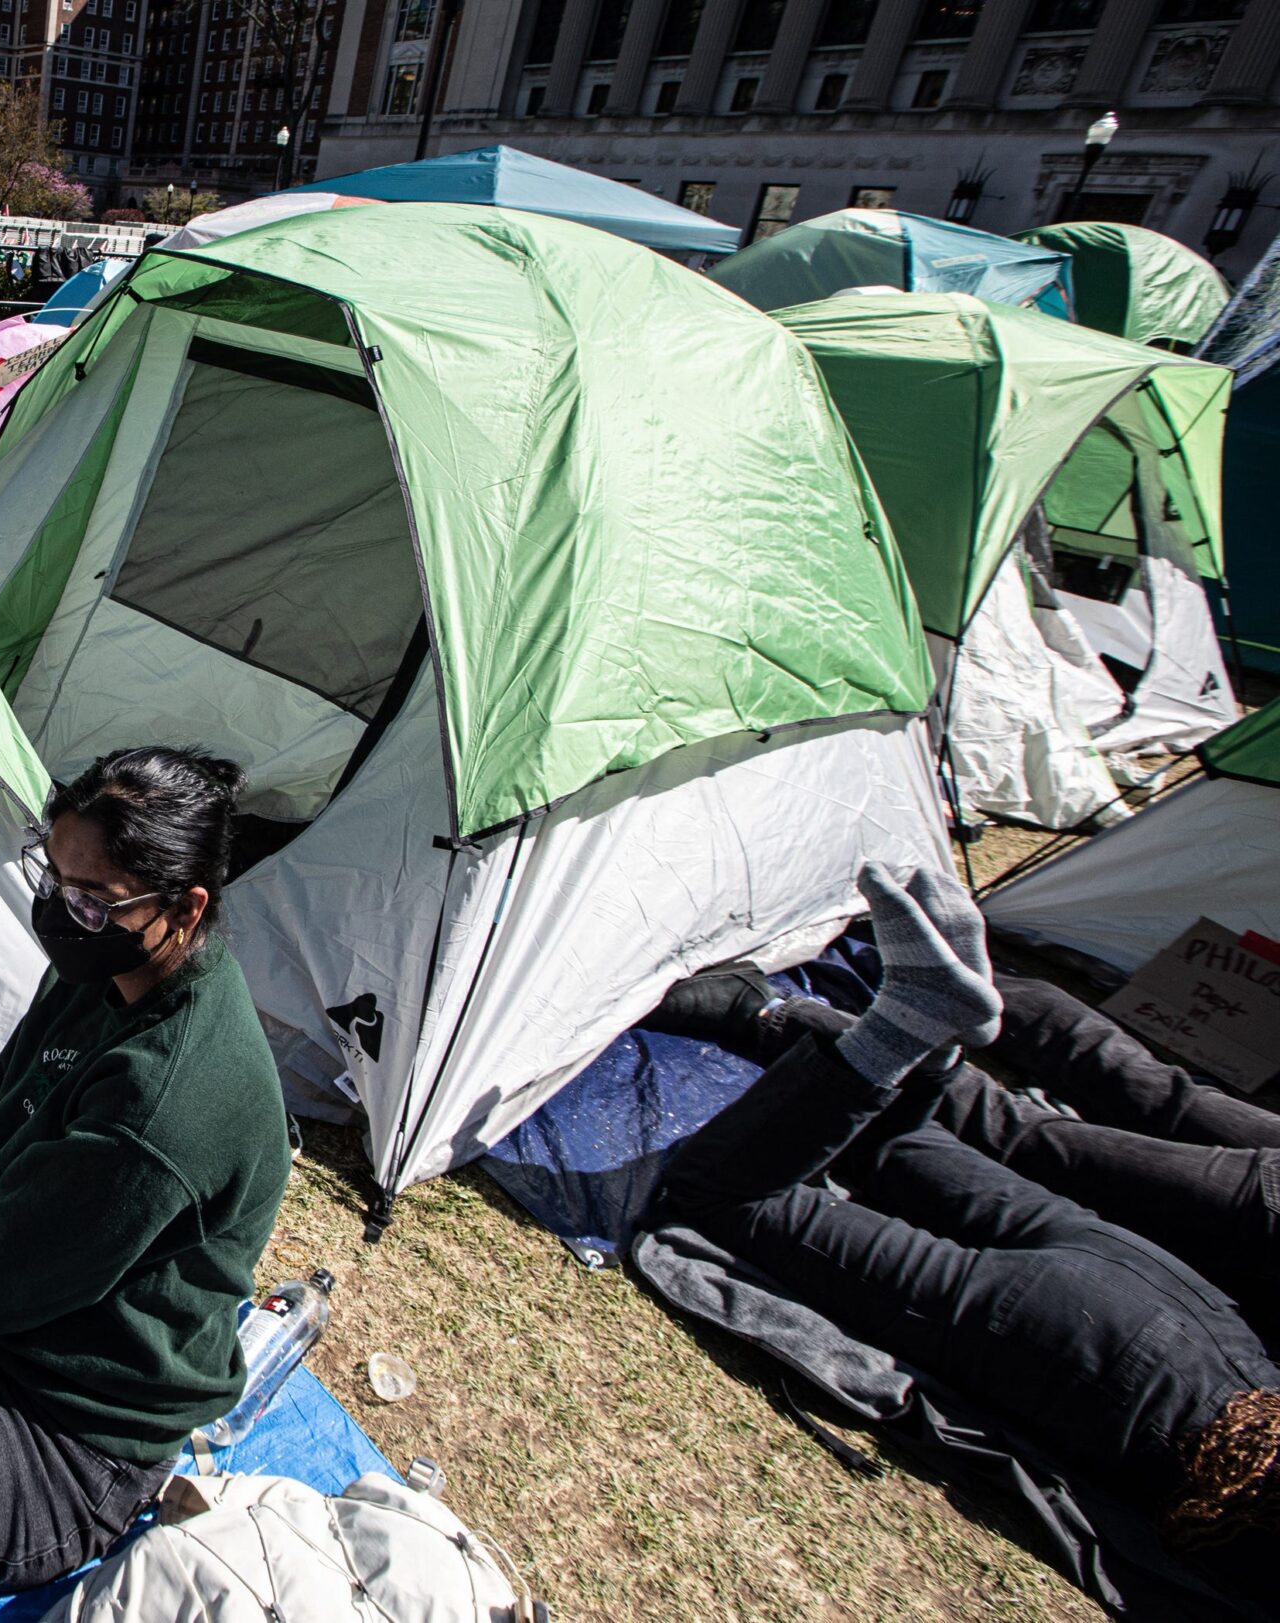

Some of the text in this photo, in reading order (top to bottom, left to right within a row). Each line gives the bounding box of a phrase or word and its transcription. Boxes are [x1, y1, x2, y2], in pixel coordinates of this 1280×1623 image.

[4, 338, 61, 367] ISRAEL
[15, 357, 46, 377] STAT
[1192, 981, 1248, 1017] Dept
[1134, 1002, 1199, 1038] Exile
